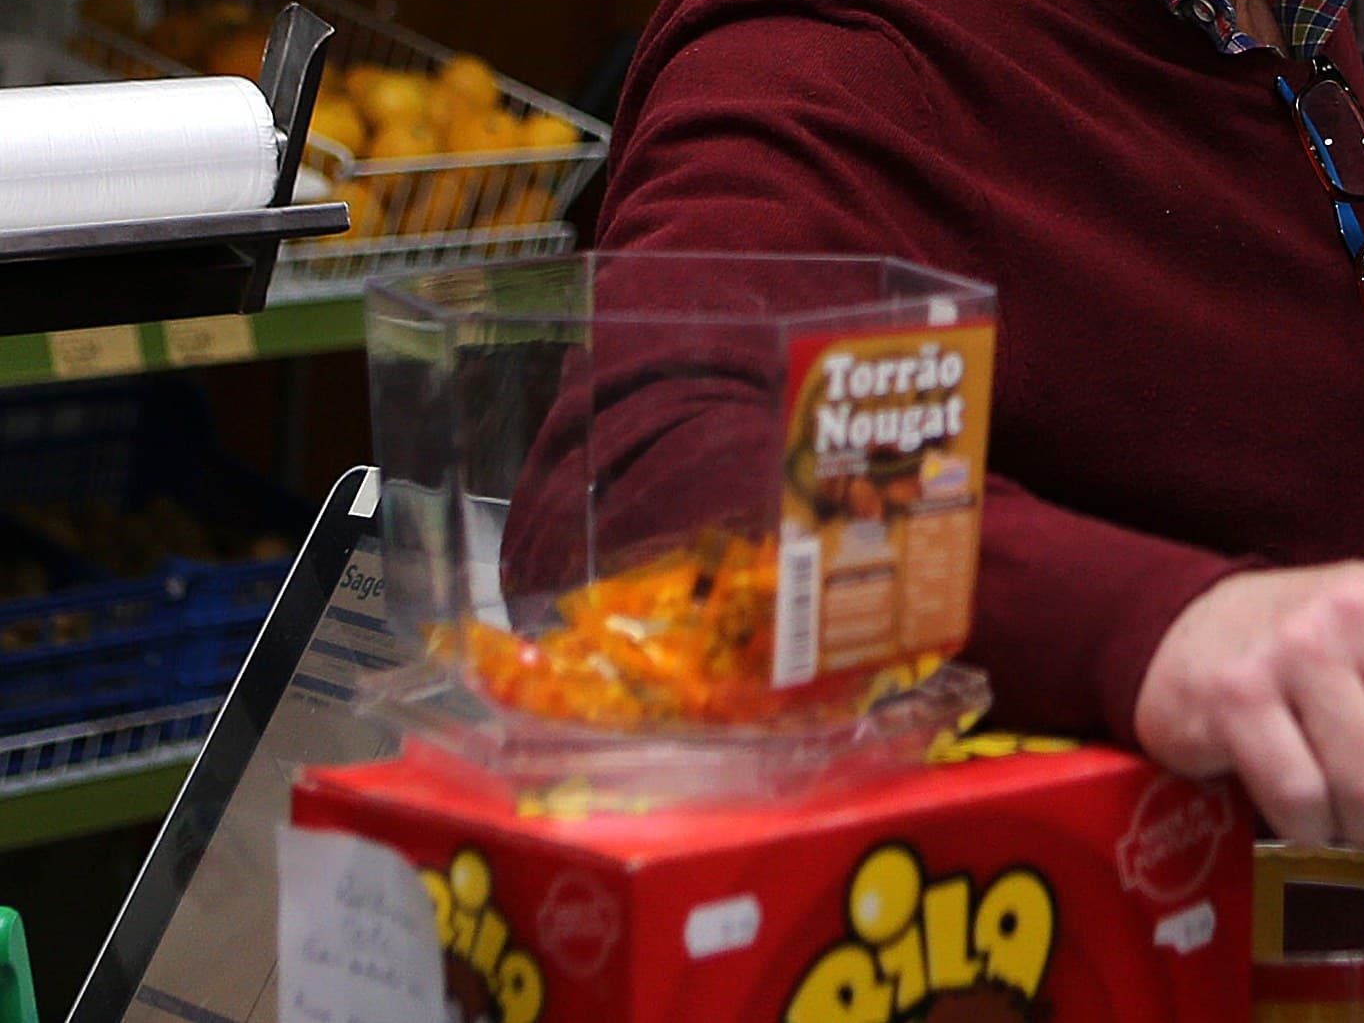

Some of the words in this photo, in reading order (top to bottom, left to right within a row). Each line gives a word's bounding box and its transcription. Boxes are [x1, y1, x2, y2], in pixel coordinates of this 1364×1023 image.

[822, 341, 967, 404] Torrão
[814, 394, 966, 455] Nougat
[340, 564, 386, 601] Sage
